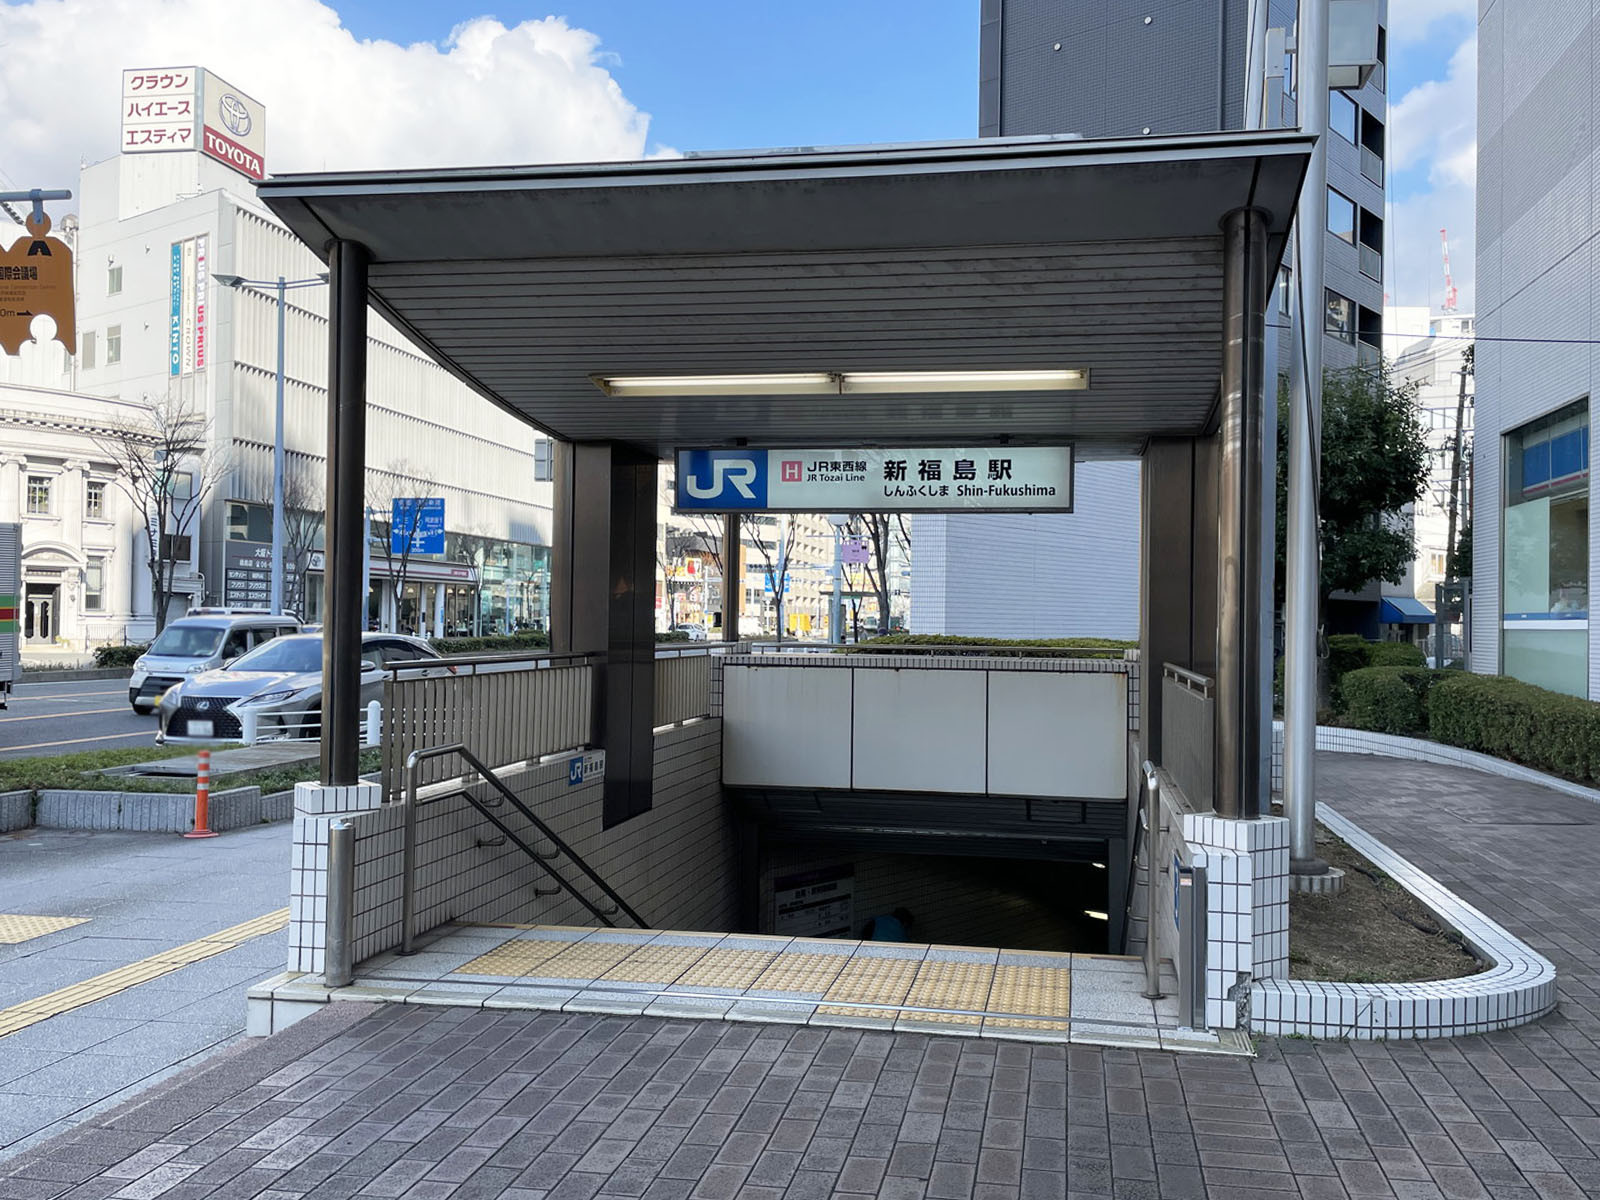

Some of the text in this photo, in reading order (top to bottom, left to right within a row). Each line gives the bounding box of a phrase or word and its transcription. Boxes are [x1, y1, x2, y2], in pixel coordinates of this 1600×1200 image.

[131, 74, 188, 90] クラウン
[128, 101, 191, 117] ハイエース
[126, 128, 191, 145] エスティマ
[206, 132, 262, 175] TOYOTA
[785, 466, 798, 480] H
[807, 461, 867, 473] JR東西線
[884, 459, 1012, 481] 新福島駅
[686, 459, 757, 499] JR
[807, 473, 866, 482] JR Tozai Line
[884, 484, 1056, 497] しんふくしま Shin-Fukushima
[571, 762, 582, 780] JR
